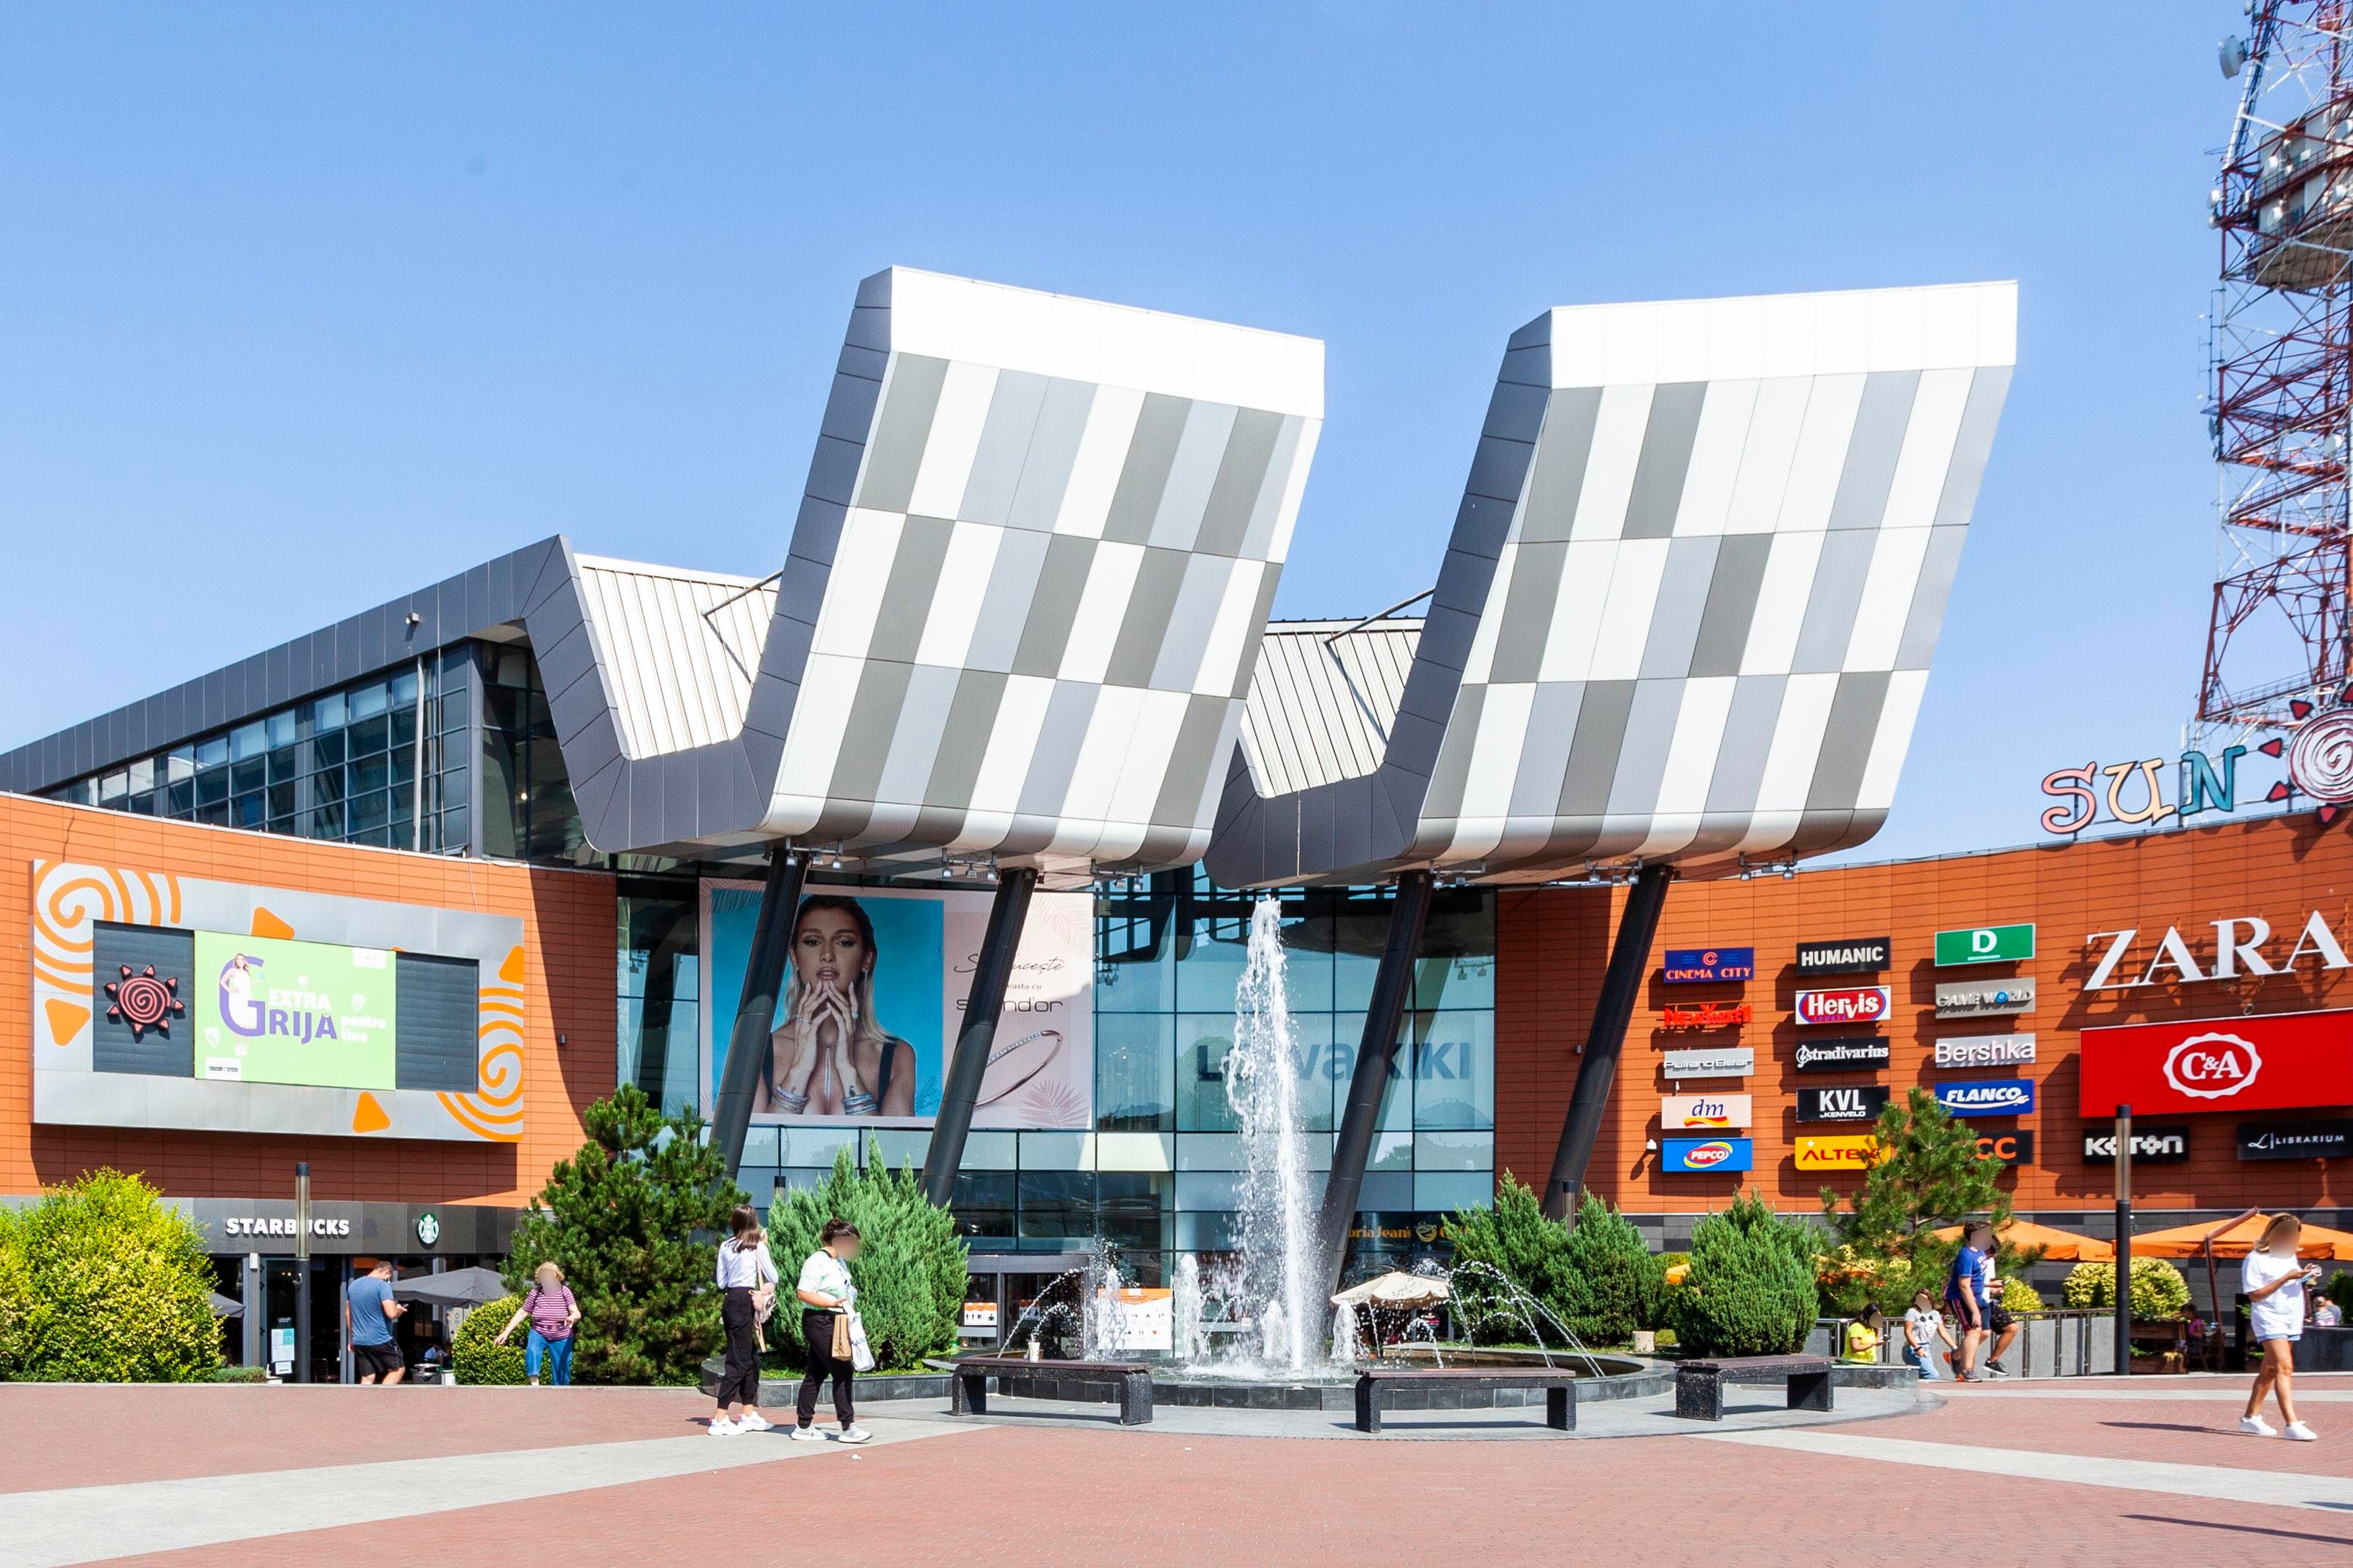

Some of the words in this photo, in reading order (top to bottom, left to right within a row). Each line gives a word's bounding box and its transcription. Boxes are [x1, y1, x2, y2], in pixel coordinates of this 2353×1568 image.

[2041, 745, 2246, 834] SUN
[1972, 930, 1998, 953] D
[2084, 911, 2353, 991] ZARA
[1801, 946, 1884, 967] HUMANIC
[1665, 969, 1713, 980] CINEMA
[1720, 968, 1752, 978] CITY
[269, 989, 331, 1010] EXTRA
[1808, 993, 1879, 1019] Hervis
[1936, 993, 1979, 1007] GAME
[1982, 988, 2033, 1004] WORLD
[1806, 1044, 1890, 1061] stradivarius
[1935, 1039, 2036, 1064] Bershka
[2181, 1051, 2244, 1081] C&A
[1819, 1089, 1866, 1111] KVL
[1946, 1087, 2022, 1102] FLANCO
[1692, 1099, 1723, 1116] dm
[1975, 1137, 2017, 1160] CC
[2275, 1134, 2345, 1145] LIBRARIUM
[1691, 1148, 1726, 1160] PEPCO
